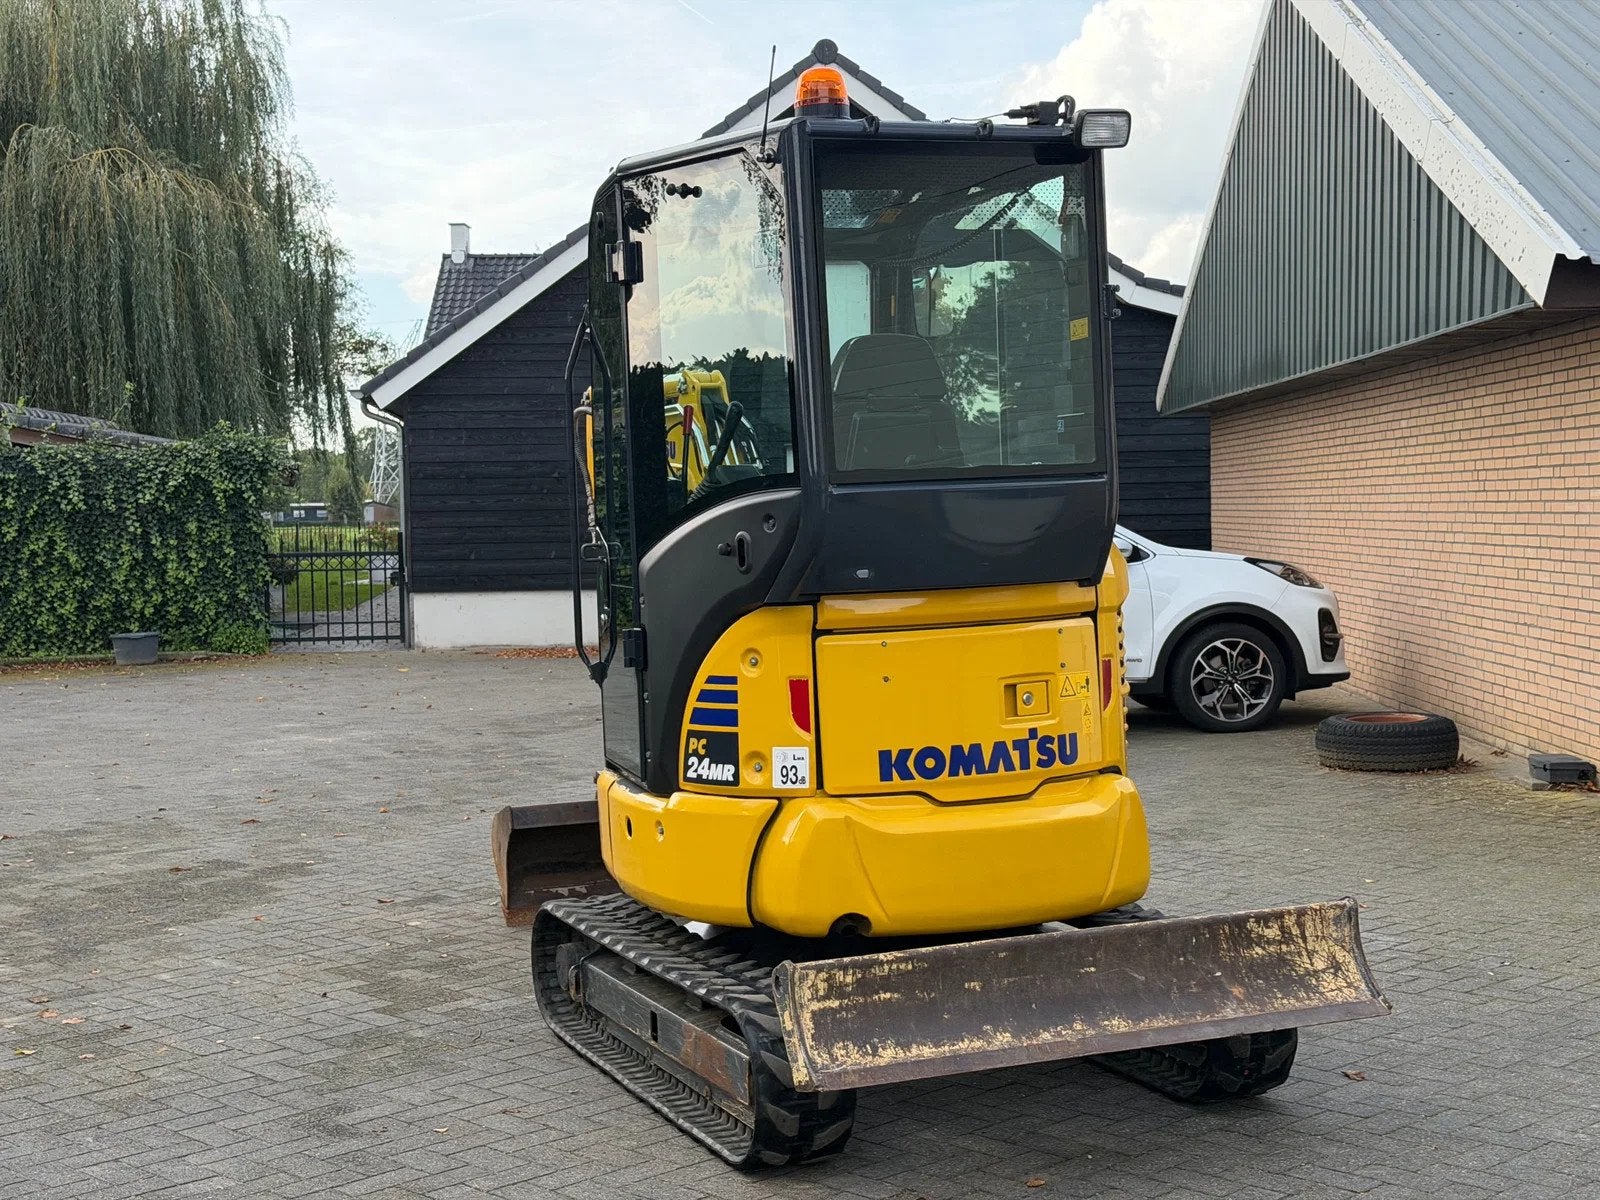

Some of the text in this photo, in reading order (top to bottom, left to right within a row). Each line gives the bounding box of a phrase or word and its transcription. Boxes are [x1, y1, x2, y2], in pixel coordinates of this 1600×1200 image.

[688, 737, 707, 755] PC
[878, 727, 1079, 782] KOMATSU
[686, 756, 736, 781] 24MR
[780, 765, 807, 785] 93 dB
